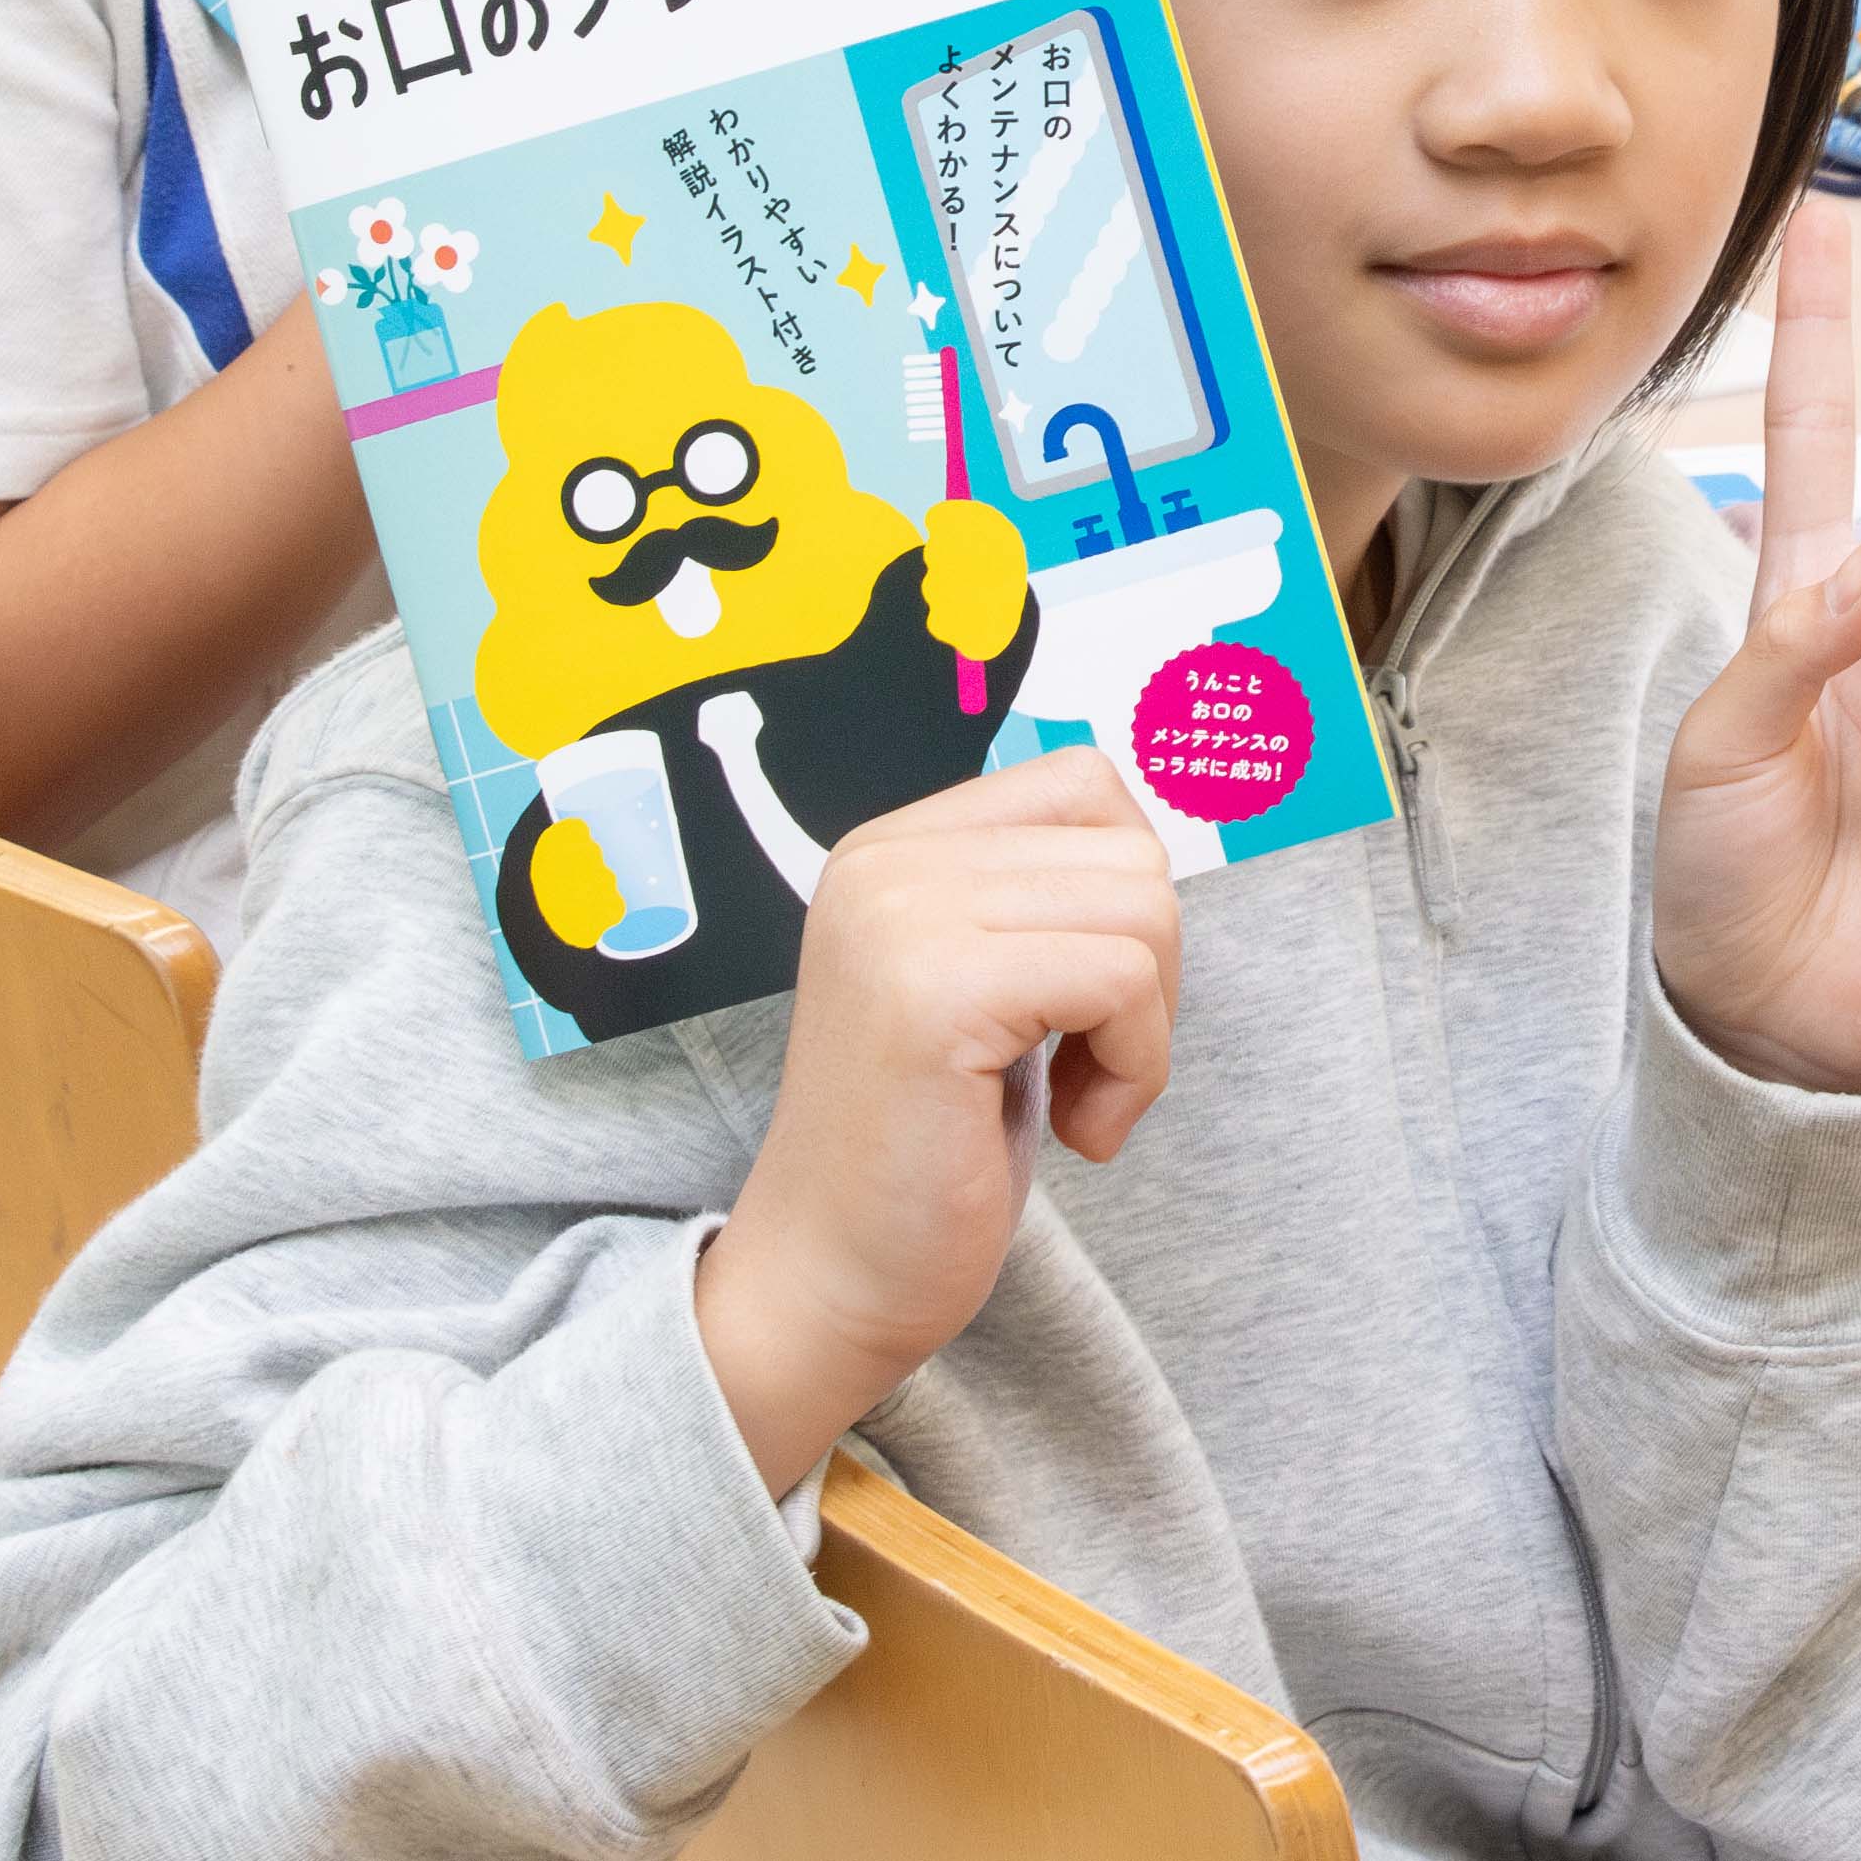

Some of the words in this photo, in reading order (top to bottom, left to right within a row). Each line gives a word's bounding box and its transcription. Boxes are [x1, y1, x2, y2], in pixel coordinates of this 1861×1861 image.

[1042, 43, 1072, 140] お口の
[709, 106, 828, 286] わかりやすい
[937, 43, 968, 252] よくわかる！
[661, 128, 818, 375] 解説イラスト付き
[989, 43, 1022, 368] メンテナンスについて
[1186, 670, 1264, 695] うんこと
[1191, 700, 1252, 722] お口の
[1148, 756, 1283, 782] コラボに成功！
[1151, 728, 1290, 753] メンテナンスの
